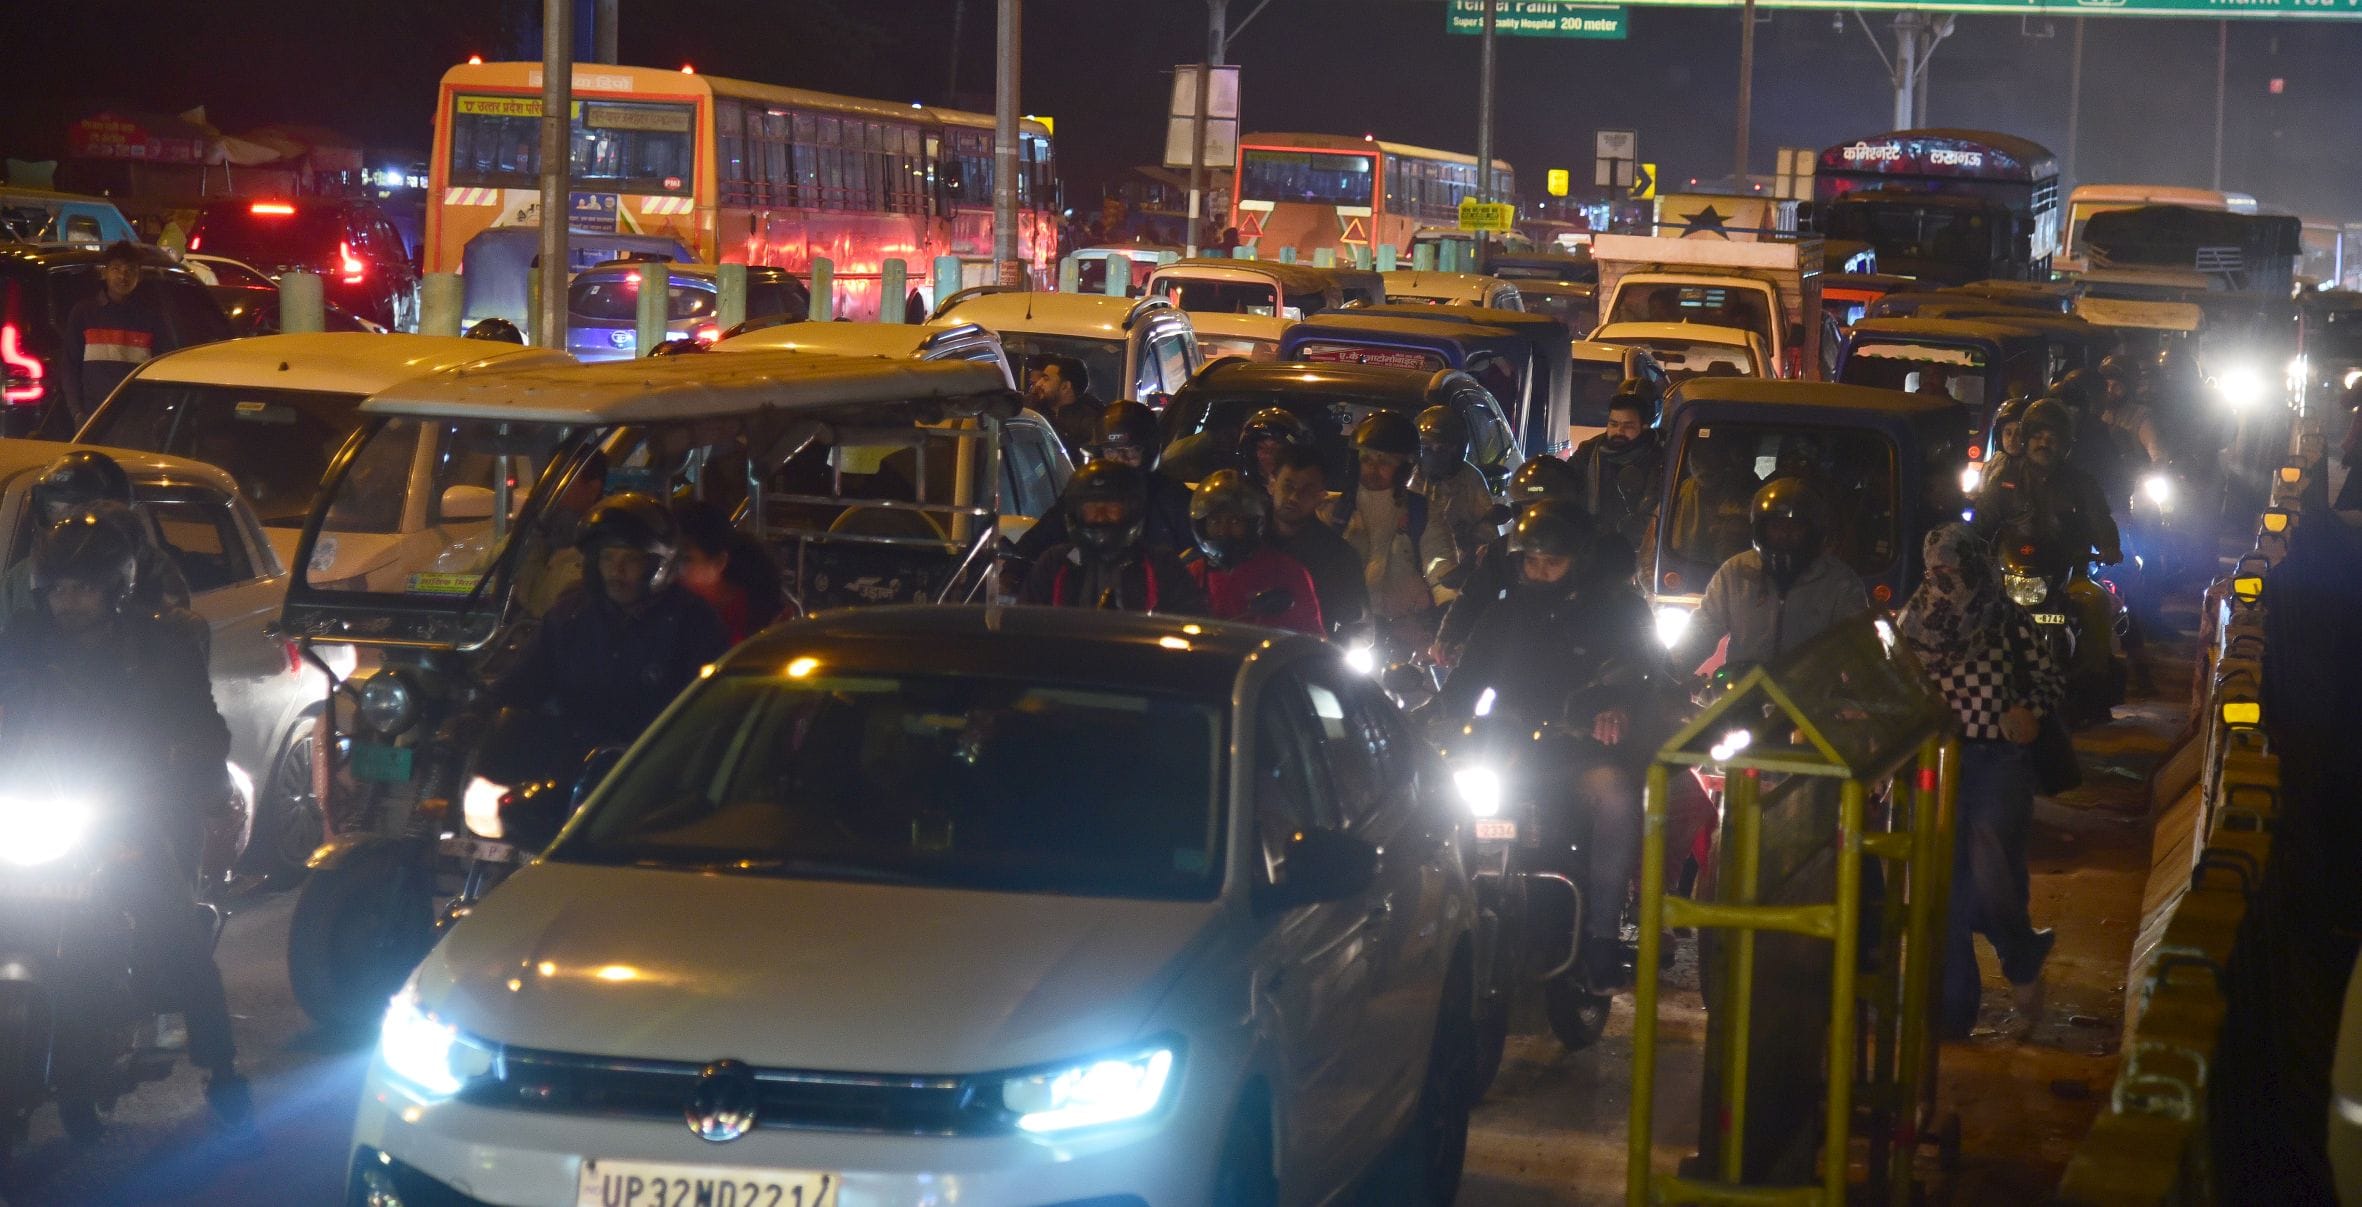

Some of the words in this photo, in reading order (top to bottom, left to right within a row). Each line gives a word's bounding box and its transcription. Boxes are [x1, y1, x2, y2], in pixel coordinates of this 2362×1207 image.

[1456, 0, 1509, 12] Tener
[1453, 16, 1478, 28] Super
[1520, 18, 1556, 30] Hospital
[1561, 17, 1582, 30] 200
[1584, 19, 1618, 31] meter
[477, 101, 501, 112] उत्तर
[503, 99, 523, 113] प्रदेश
[1930, 149, 1983, 166] लखनऊ
